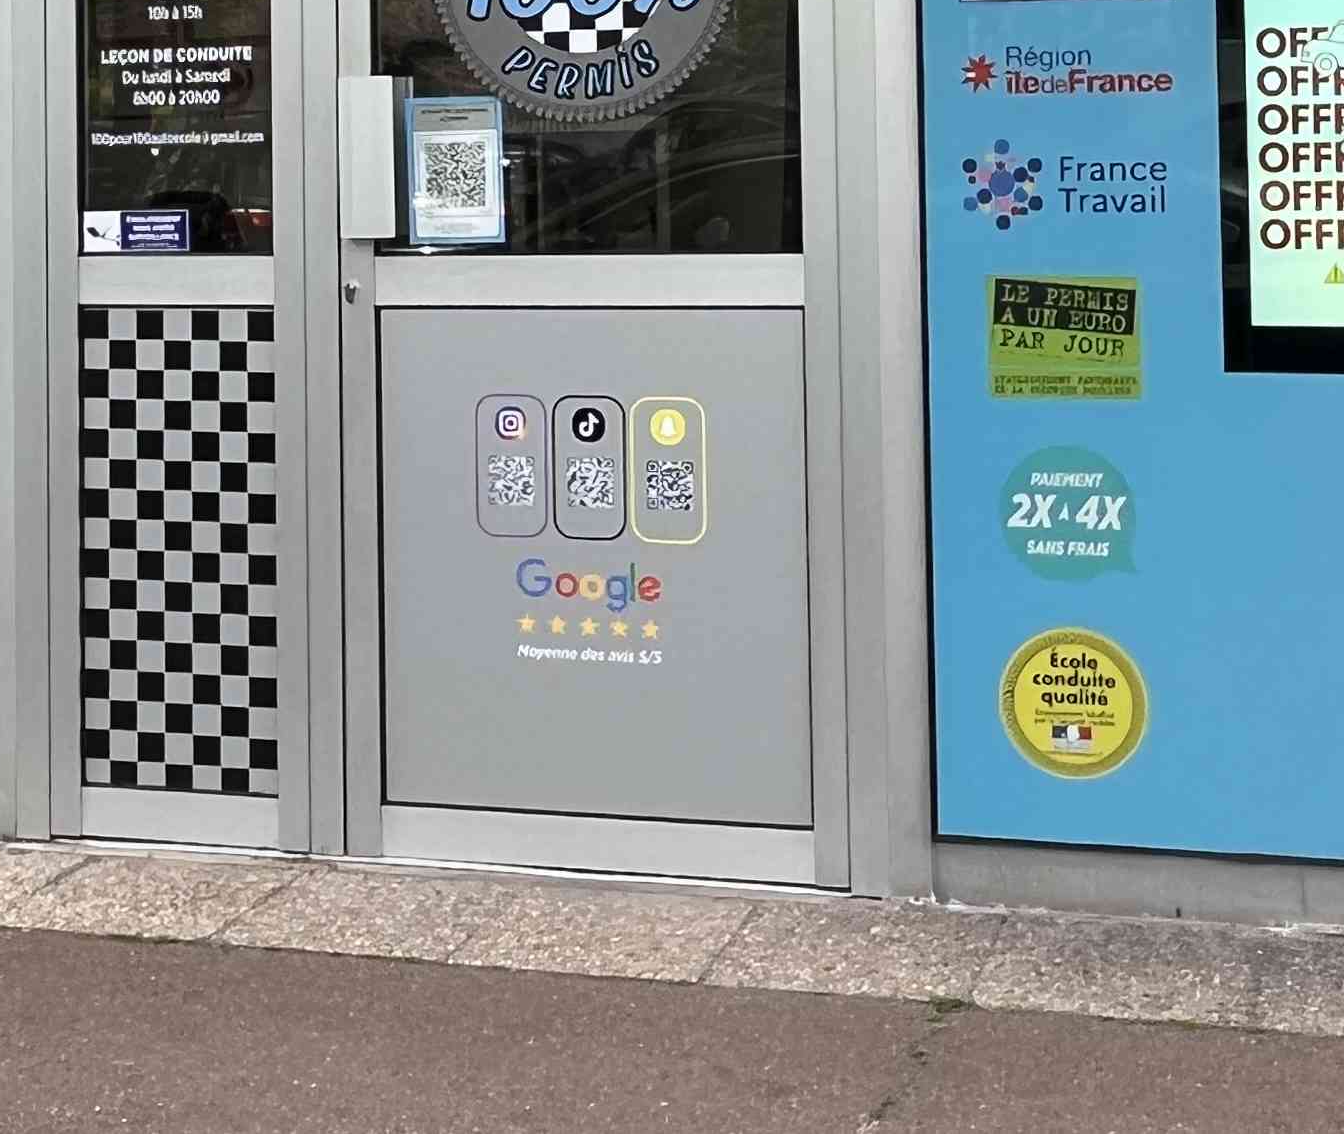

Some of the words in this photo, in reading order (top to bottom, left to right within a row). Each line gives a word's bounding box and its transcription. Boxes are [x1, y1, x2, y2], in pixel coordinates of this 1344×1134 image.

[101, 48, 150, 66] LEÇON
[153, 47, 172, 63] DE
[176, 46, 252, 63] CONDUITE
[1006, 46, 1091, 72] Région
[122, 71, 139, 85] Du
[179, 90, 220, 105] 20h00
[1059, 156, 1167, 182] France
[1058, 185, 1166, 214] Travail
[1001, 283, 1029, 303] LE
[1044, 288, 1128, 311] PERMIS
[1000, 308, 1015, 323] A
[1027, 308, 1057, 327] UN
[1068, 310, 1126, 333] EURO
[999, 329, 1044, 349] PAR
[1064, 335, 1125, 356] JOUR
[1030, 472, 1103, 487] PAIEMENT
[1007, 493, 1056, 528] 2X
[1076, 496, 1127, 530] 4X
[1027, 540, 1064, 555] SANS
[1068, 541, 1109, 556] FRAIS
[516, 558, 662, 612] Google
[517, 644, 578, 661] Moyenne
[580, 647, 605, 661] des
[608, 650, 634, 663] avis
[639, 650, 663, 665] 5/5
[1050, 647, 1098, 670] École
[1033, 670, 1116, 688] conduite
[1041, 689, 1108, 707] qualité
